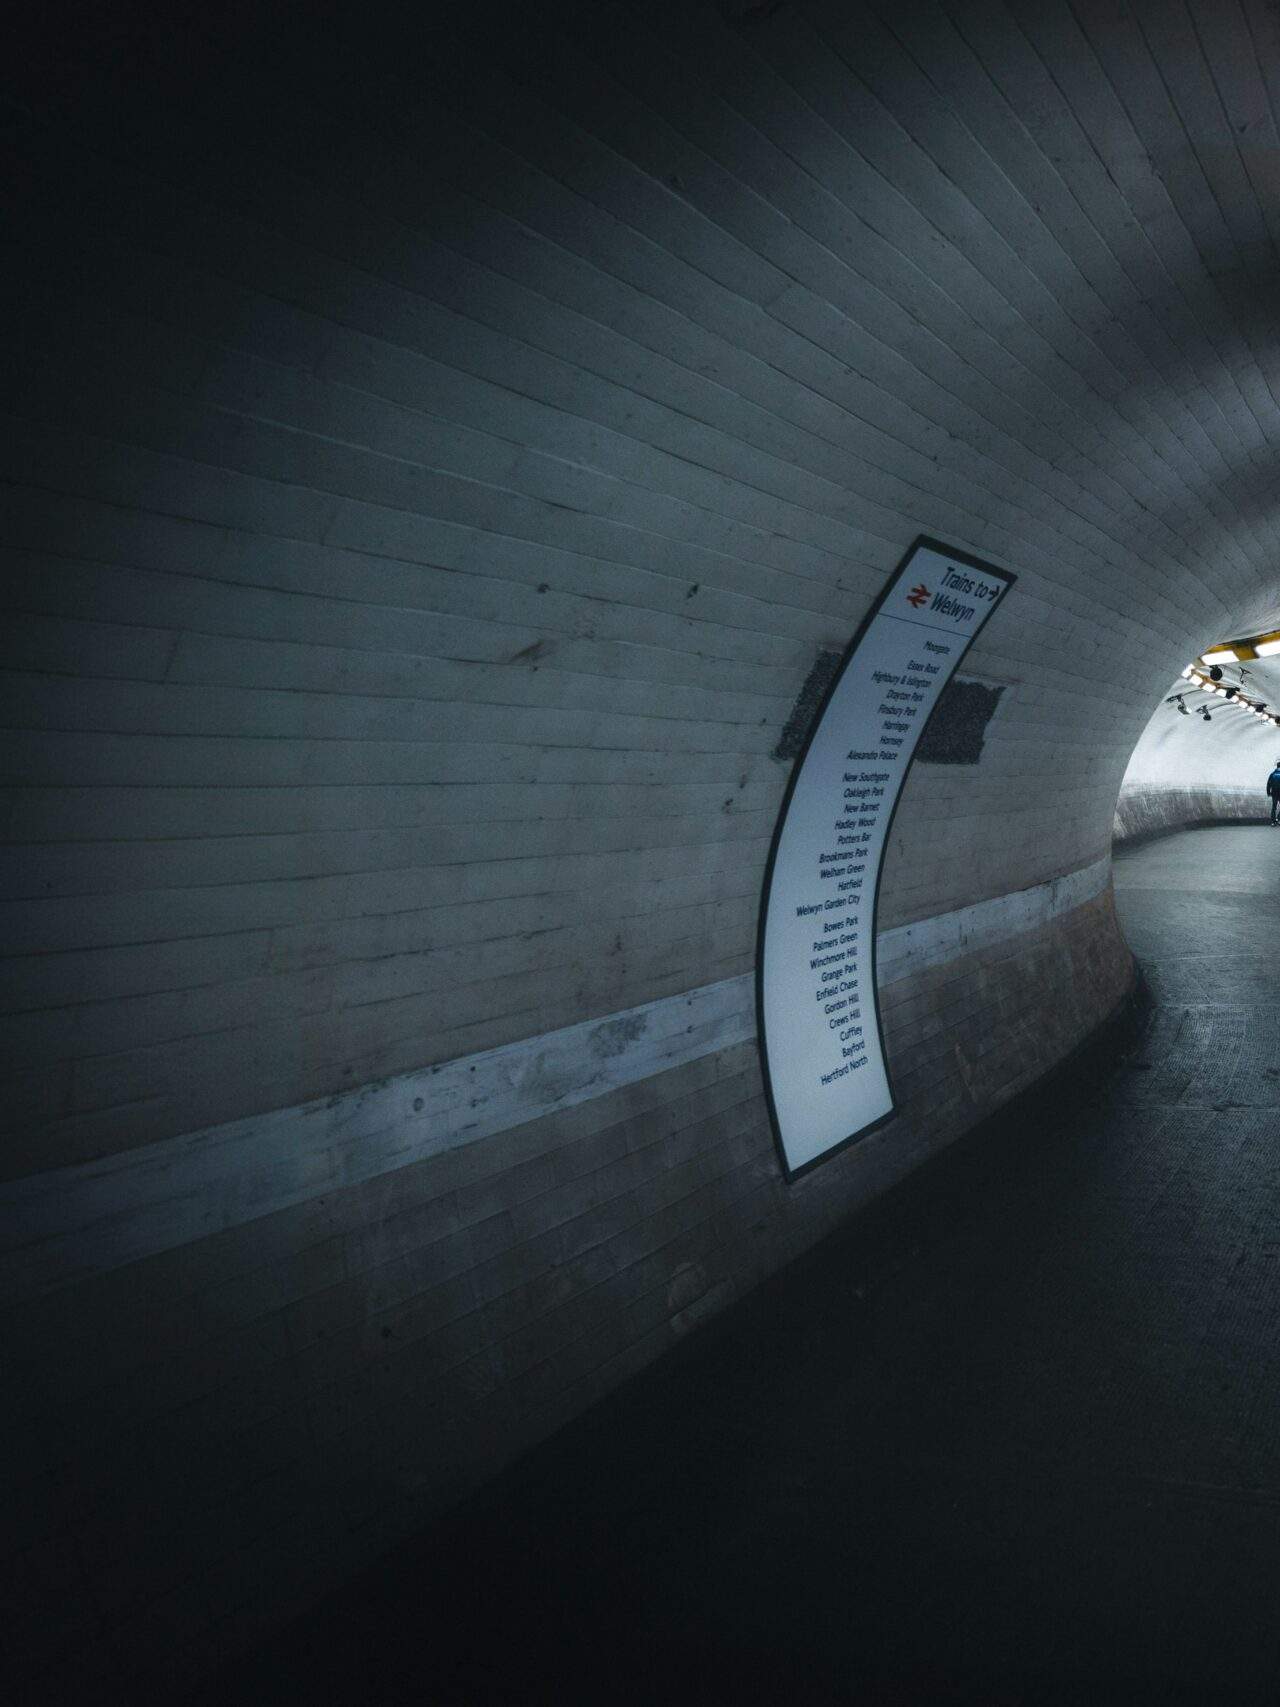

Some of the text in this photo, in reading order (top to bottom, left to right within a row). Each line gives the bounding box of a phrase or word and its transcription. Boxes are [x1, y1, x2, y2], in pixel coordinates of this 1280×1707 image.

[940, 566, 988, 599] Trains to
[930, 592, 975, 623] Welwyn
[907, 659, 941, 674] Essex Road
[871, 670, 932, 689] Highbury & Islington
[886, 689, 925, 702] Drayton Park
[877, 704, 917, 718] Finsbury Park
[880, 735, 904, 747] Hornsey
[847, 750, 898, 760] Alexandra Palace
[842, 771, 890, 784] New Southgate
[843, 787, 885, 799] Oakleigh Park
[844, 802, 880, 813] New Barnet
[834, 817, 876, 830] Hadley Wood
[837, 832, 872, 845] Potters Bar
[818, 848, 868, 864] Brookmans Park
[820, 864, 865, 879] Welham Green
[837, 878, 863, 892] Hatfield
[796, 894, 860, 917] Welwyn Garden City
[824, 916, 858, 933] Bowes Park
[813, 933, 858, 952] Palmers Green
[810, 946, 858, 970] Winchmore Hill
[821, 962, 858, 982] Grange Park
[816, 979, 858, 1001] Enfield Chase
[824, 993, 859, 1014] Gordon Hill
[829, 1008, 861, 1029] Crews Hill
[840, 1025, 862, 1041] Cuffley
[842, 1040, 866, 1057] Bayford
[820, 1056, 869, 1085] Hertford North
